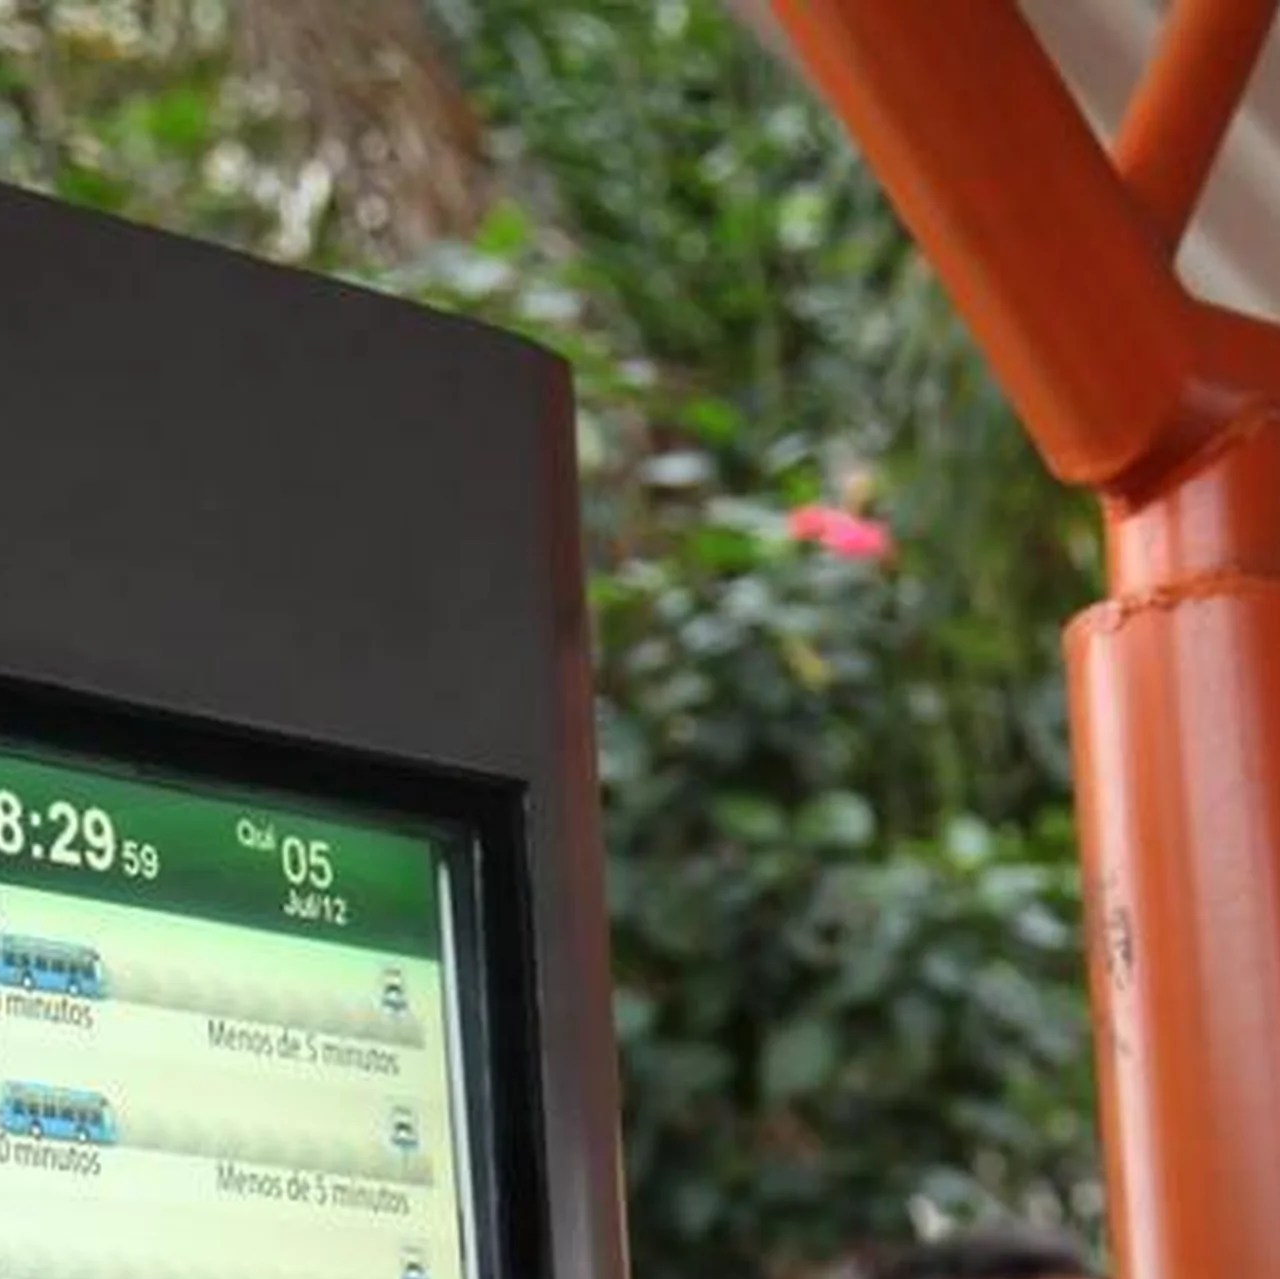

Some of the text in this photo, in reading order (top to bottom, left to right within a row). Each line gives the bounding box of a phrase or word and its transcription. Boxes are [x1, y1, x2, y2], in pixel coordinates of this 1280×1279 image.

[122, 845, 160, 880] 59
[281, 836, 334, 890] 05
[283, 887, 348, 927] Jul/12
[5, 988, 95, 1029] minutos
[208, 1019, 273, 1057] Menos
[276, 1025, 301, 1059] de
[13, 1138, 102, 1176] minutos
[217, 1159, 283, 1198] Menos
[287, 1166, 311, 1201] de
